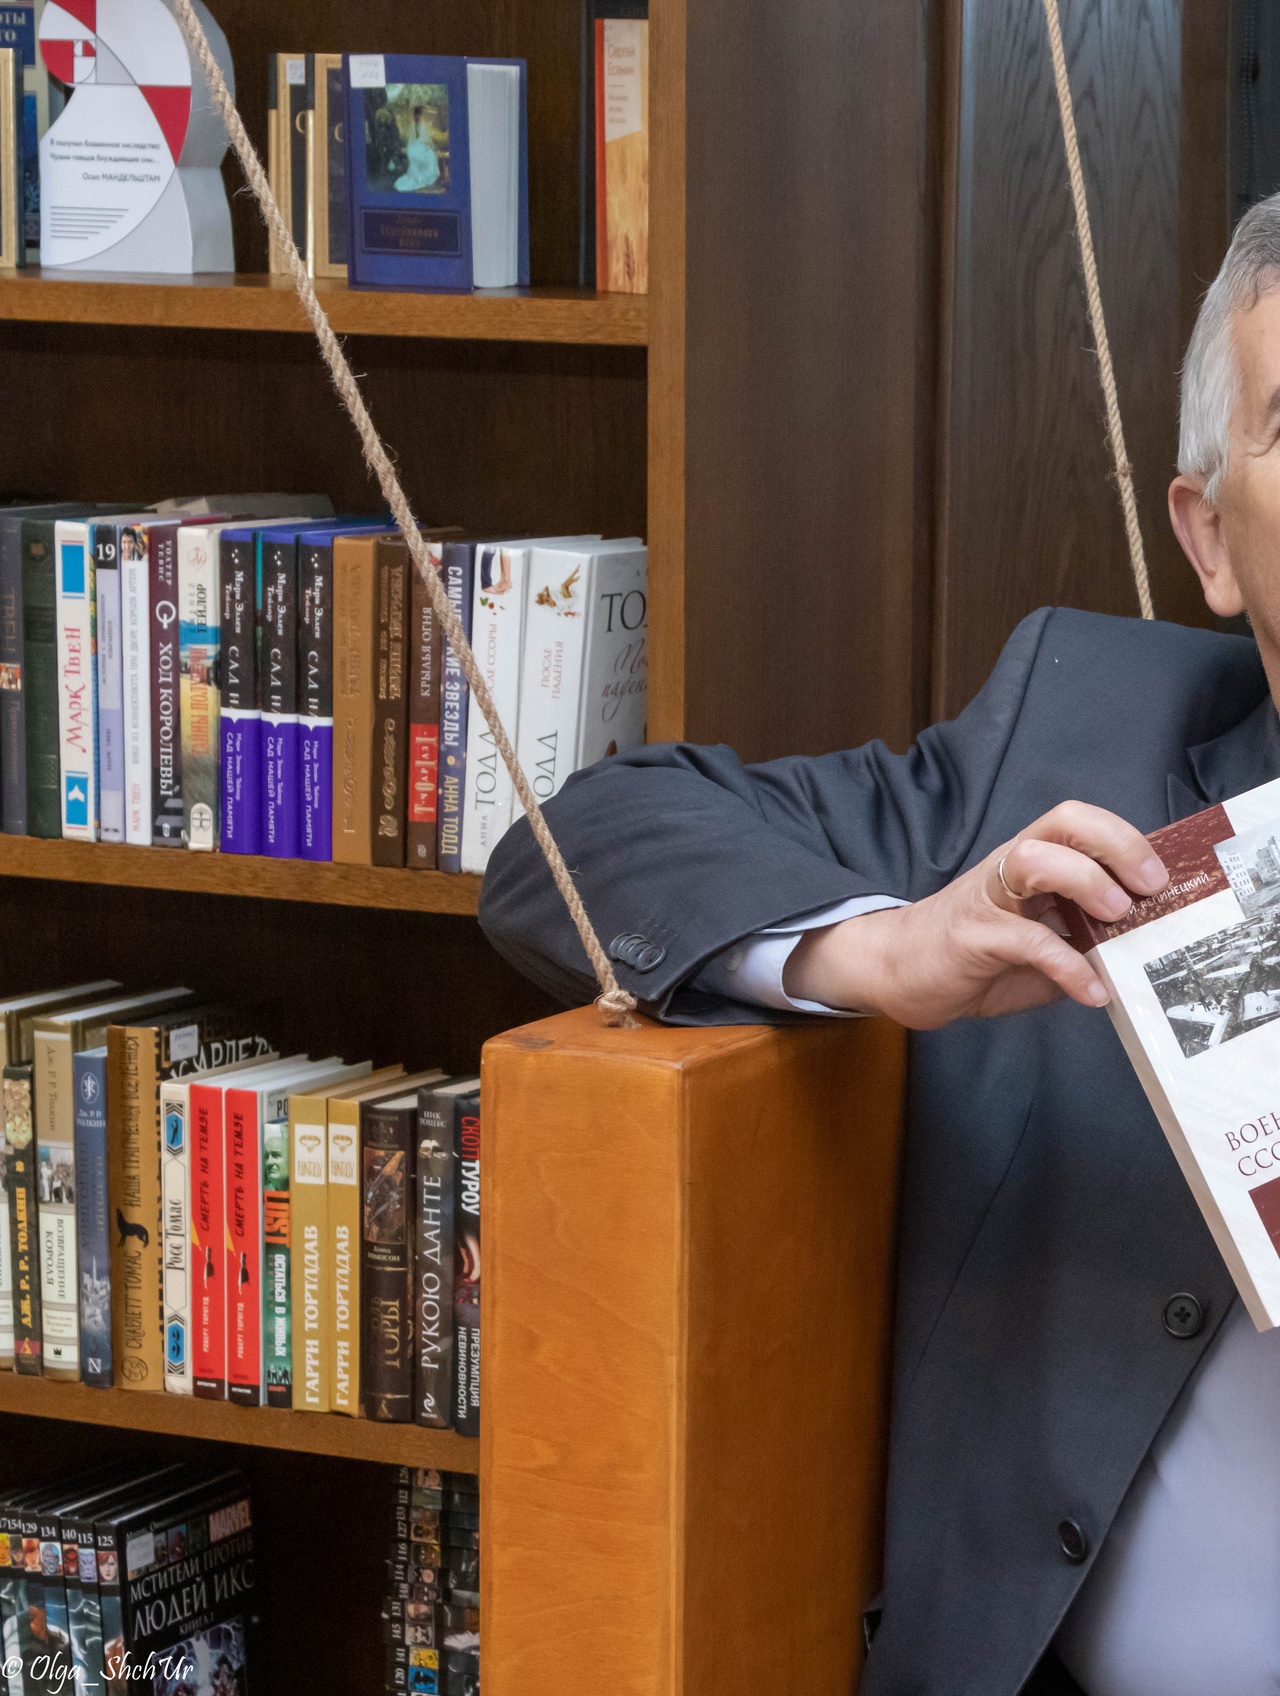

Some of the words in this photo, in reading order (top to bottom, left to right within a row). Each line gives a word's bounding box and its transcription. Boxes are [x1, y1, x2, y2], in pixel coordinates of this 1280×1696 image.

[101, 173, 161, 182] МАНДЕЛЬШТАМ
[96, 543, 116, 560] 19
[233, 570, 244, 600] Мэри
[275, 572, 286, 602] Мэри
[312, 575, 323, 605] Мэри
[234, 603, 244, 634] Эллен
[277, 605, 286, 636] Эллен
[314, 607, 323, 638] Эллен
[422, 607, 432, 641] ОГНЯ
[601, 590, 647, 632] ТО
[64, 627, 81, 677] ТВЕН
[159, 642, 173, 683] ХОД
[487, 623, 497, 665] ССОРЫ
[228, 646, 239, 684] САД
[270, 648, 281, 686] САД
[308, 651, 318, 689] САД
[421, 646, 432, 697] КРЫЛЬЯ
[541, 648, 552, 688] ПОСЛЕ
[552, 641, 564, 699] ПАДЕНИЯ
[444, 681, 460, 746] ЗВЕЗДЫ
[159, 688, 173, 796] КОРОЛЕВЫ
[226, 732, 234, 753] САД
[267, 761, 275, 798] НАШЕЙ
[304, 764, 312, 801] НАШЕЙ
[533, 730, 558, 798] ОДД
[132, 783, 140, 805] ТВЕН
[443, 775, 459, 813] АННА
[132, 809, 140, 832] МАРК
[267, 801, 275, 843] ПАМЯТИ
[441, 816, 459, 855] ТОДД
[480, 815, 488, 847] АННА
[1140, 872, 1210, 910] РЕПИНЕЦКИЙ
[198, 1107, 209, 1151] ТЕМЗЕ
[419, 1118, 447, 1128] ТОШЕС
[423, 1110, 441, 1118] НИК
[233, 1111, 244, 1157] ТЕМЗЕ
[200, 1157, 209, 1173] НА
[235, 1162, 244, 1179] НА
[200, 1181, 210, 1232] СМЕРТЬ
[461, 1160, 480, 1216] ТУРОУ
[16, 1186, 29, 1252] ТОЛКИН
[166, 1199, 185, 1239] Томас
[234, 1186, 245, 1238] СМЕРТЬ
[422, 1176, 442, 1266] ДАНТЕ
[18, 1256, 30, 1272] Р.
[45, 1230, 54, 1286] КОРОЛЯ
[56, 1218, 66, 1299] ВОЗВРАЩЕНИЕ
[124, 1250, 142, 1292] ТОМАС
[166, 1243, 185, 1271] Росс
[19, 1274, 30, 1291] Р.
[274, 1254, 286, 1303] ОСТАТЬСЯ
[304, 1225, 320, 1331] ТОРТЛДАВ
[336, 1225, 351, 1332] ТОРТЛДАВ
[274, 1306, 286, 1314] В
[421, 1272, 442, 1369] РУКОЮ
[275, 1316, 287, 1357] ЖИВЫХ
[305, 1339, 320, 1404] ГАРРИ
[336, 1340, 350, 1406] ГАРРИ
[457, 1326, 467, 1419] НЕВИНОВНОСТИ
[470, 1328, 480, 1407] ПРЕЗУМПЦИЯ
[22, 1523, 37, 1533] 129
[41, 1526, 56, 1537] 134
[61, 1528, 76, 1539] 140
[77, 1532, 93, 1543] 115
[97, 1535, 114, 1546] 125
[129, 1560, 200, 1603] МСТИТЕЛИ
[133, 1576, 206, 1641] ЛЮДЕЙ
[214, 1559, 255, 1604] ИКС
[392, 1623, 401, 1639] 145
